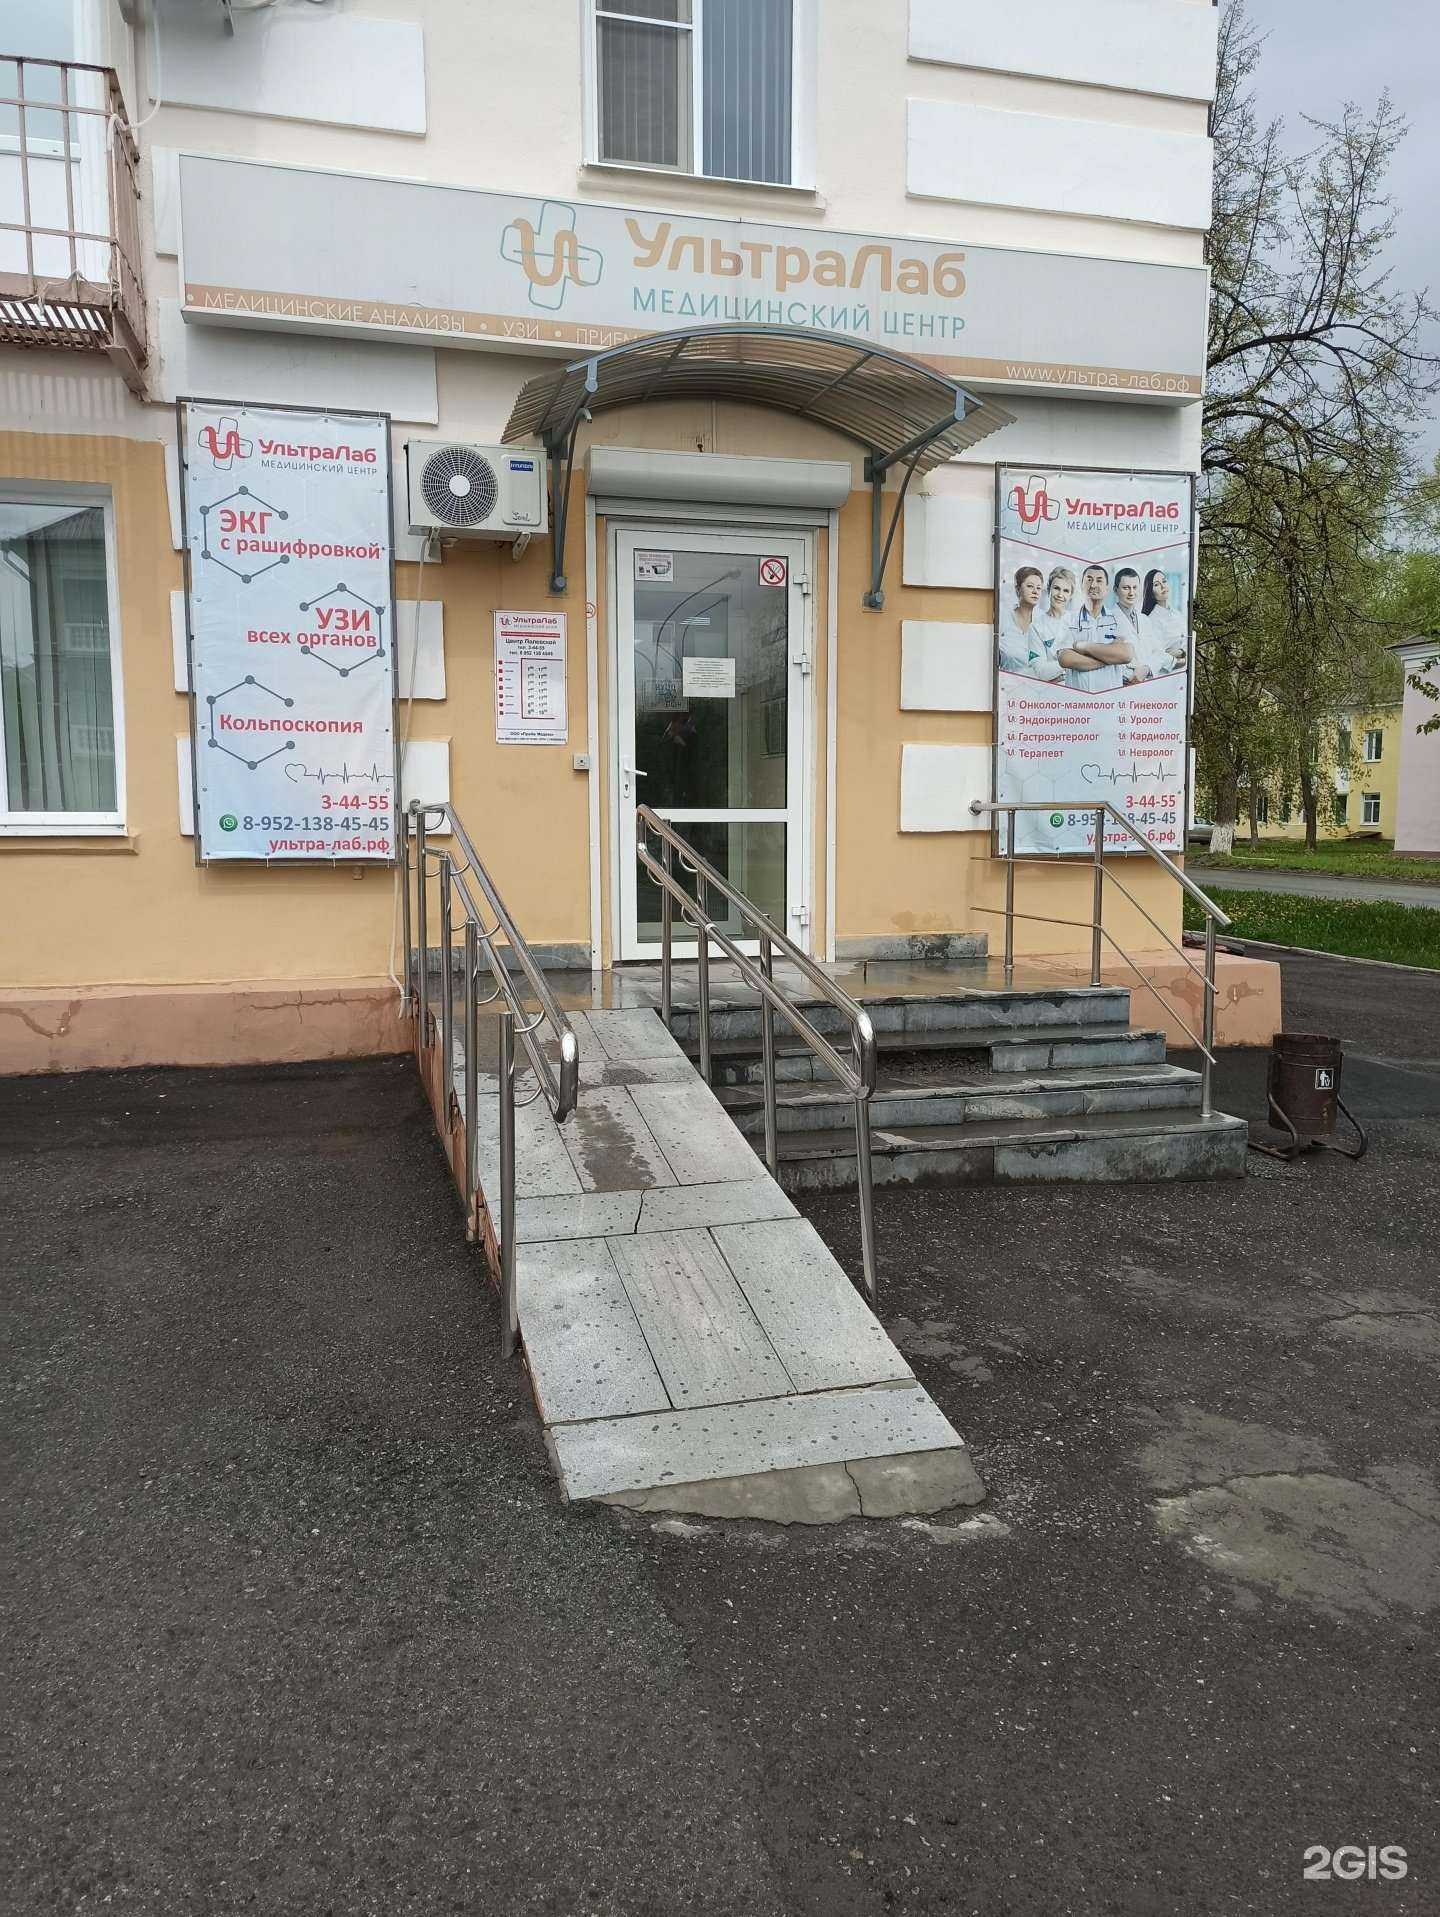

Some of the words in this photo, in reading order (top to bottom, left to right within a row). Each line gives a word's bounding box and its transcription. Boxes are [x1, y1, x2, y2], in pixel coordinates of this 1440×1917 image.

[624, 217, 967, 299] УльтраЛаб
[204, 291, 364, 322] МЕДИЦИНСКИЕ
[369, 307, 466, 333] АНАЛИЗЫ
[502, 319, 541, 342] УЗИ
[632, 286, 871, 333] МЕДИЦИНСКИЙ
[883, 310, 966, 340] ЦЕНТР
[1005, 363, 1191, 394] www.ультра-лаб.рф
[258, 438, 377, 463] УльтраЛаб
[260, 459, 344, 474] МЕДИЦИНСКИЙ
[347, 468, 378, 476] ЦЕНТР
[1065, 497, 1179, 520] УльтраЛаб
[219, 508, 273, 534] ЭКГ
[1067, 520, 1147, 532] МЕДИЦИНСКИЙ
[1150, 524, 1179, 533] ЦЕНТР
[220, 537, 231, 550] с
[236, 537, 381, 560] рашифровкой
[315, 607, 371, 632] УЗИ
[247, 630, 291, 645] всех
[296, 632, 378, 649] органов
[1018, 699, 1115, 711] Онколог-маммолог
[1129, 700, 1179, 711] Гинеколог
[219, 713, 363, 734] Кольпоскопия
[1018, 715, 1091, 727] Эндокринолог
[1129, 715, 1163, 726] Уролог
[1018, 732, 1099, 743] Гастроэнтеролог
[1129, 731, 1181, 742] Кардиолог
[1018, 748, 1064, 759] Терапевт
[1129, 748, 1174, 758] Невролог
[321, 794, 389, 810] 3-44-55
[1126, 795, 1176, 809] 3-44-55
[242, 815, 390, 832] 8-952-138-45-45
[1067, 812, 1176, 826] 8-95-18-45-45
[269, 836, 390, 854] ультра-лаб.рф
